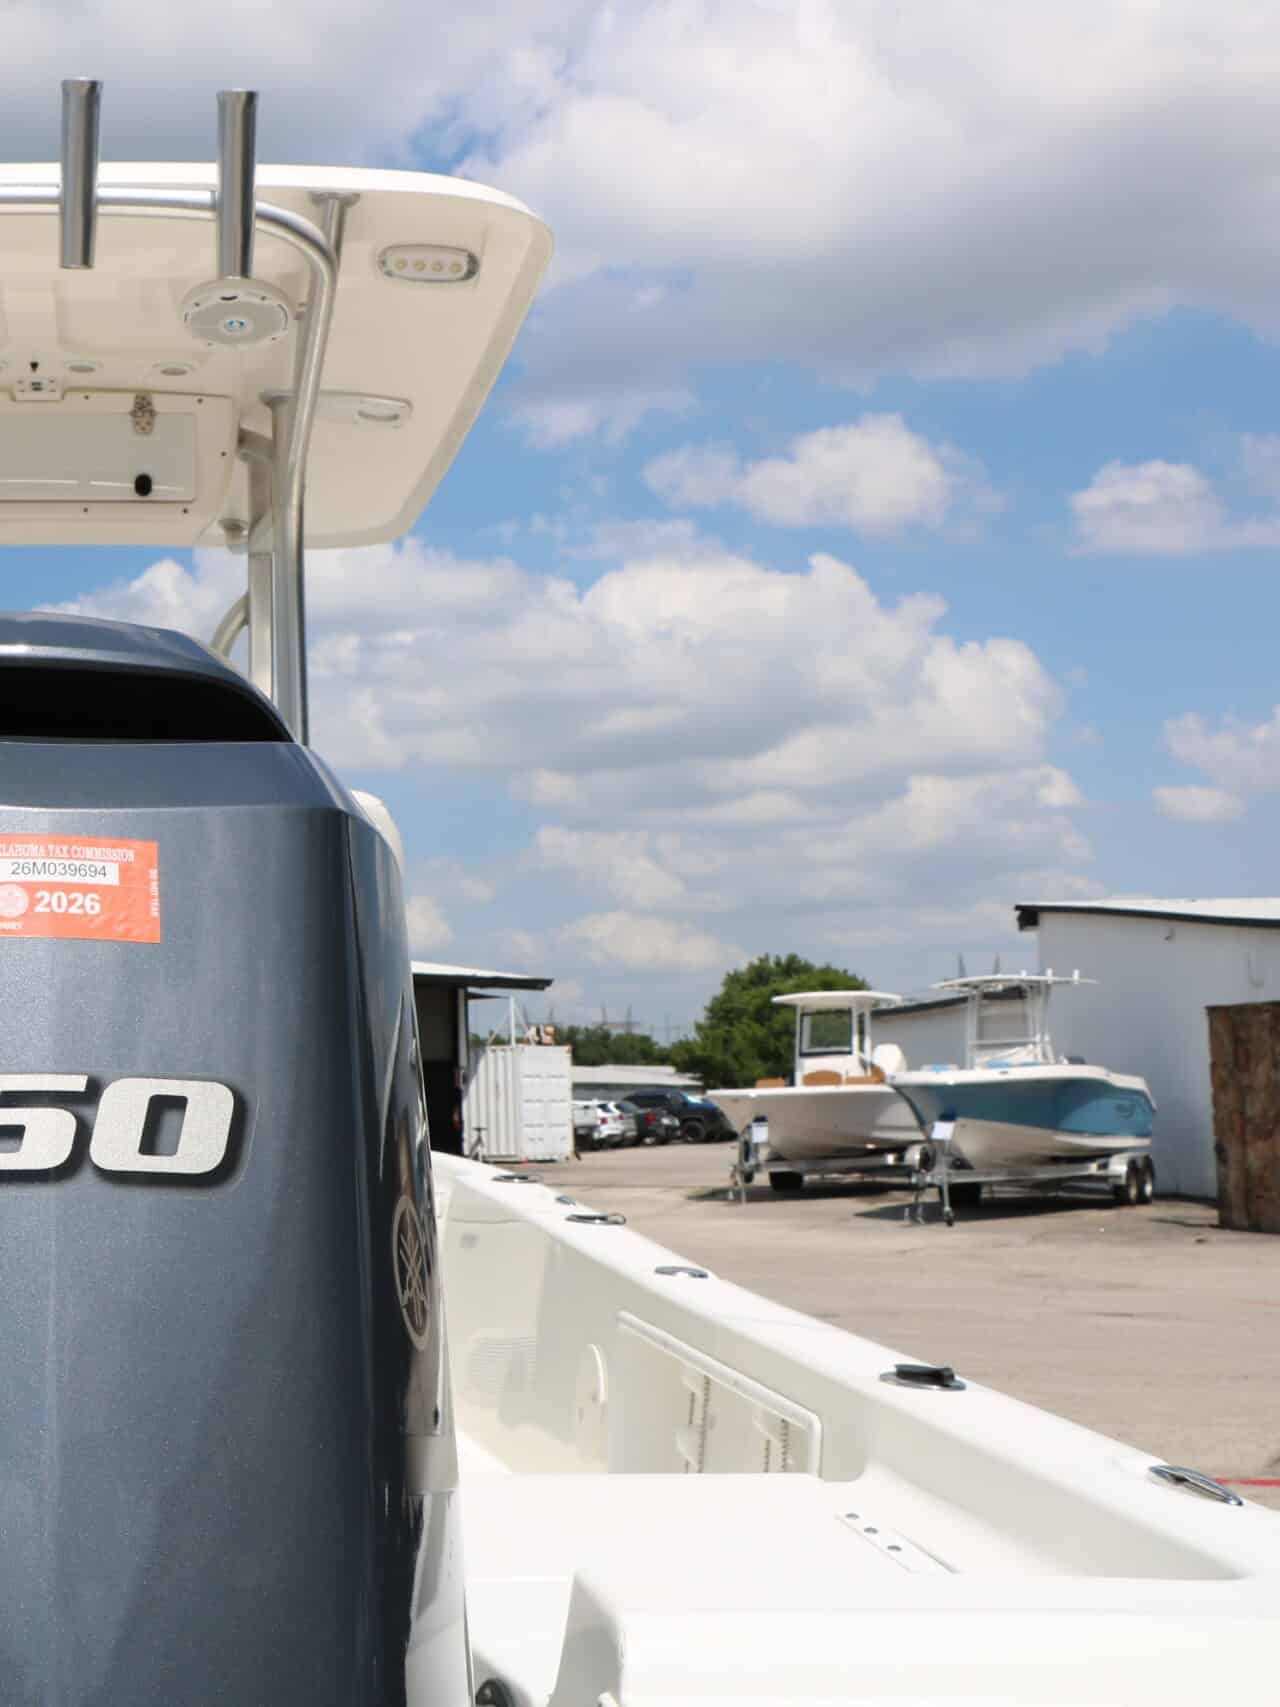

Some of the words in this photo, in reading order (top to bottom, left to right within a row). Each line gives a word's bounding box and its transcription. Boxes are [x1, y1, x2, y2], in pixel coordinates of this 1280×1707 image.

[48, 844, 70, 858] TAX
[70, 846, 134, 863] COMMISSION
[10, 861, 107, 878] 26M039694
[34, 890, 101, 914] 2026
